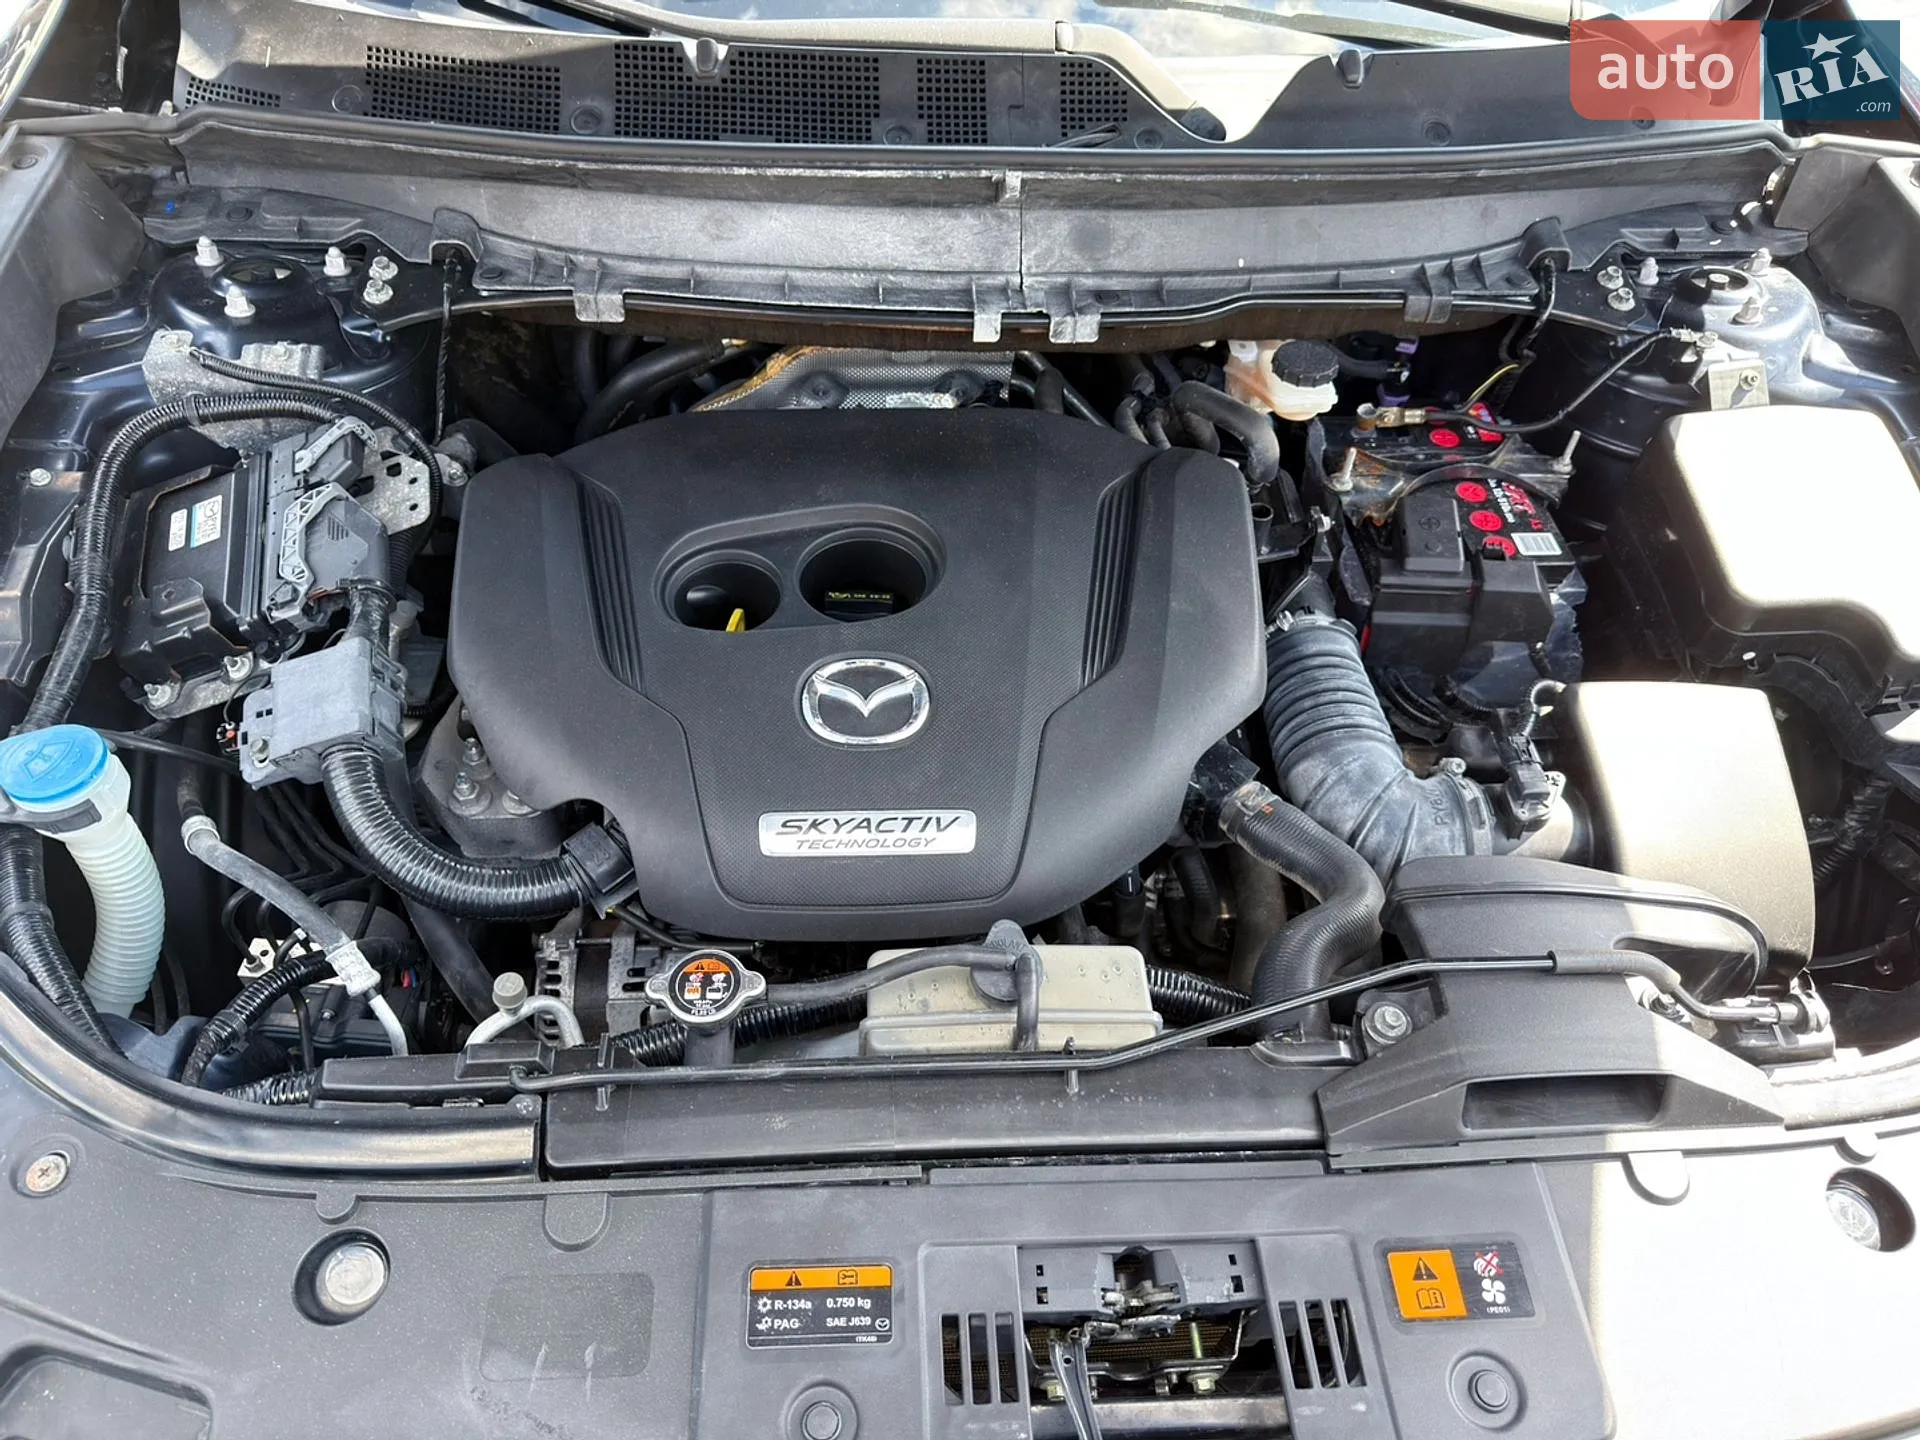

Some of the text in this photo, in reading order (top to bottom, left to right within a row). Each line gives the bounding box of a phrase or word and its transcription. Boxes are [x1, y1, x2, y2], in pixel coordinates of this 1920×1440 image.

[775, 816, 961, 836] SKYACTIV
[796, 837, 936, 850] TECHNOLOGY
[774, 1299, 812, 1310] R-134a
[826, 1297, 871, 1310] 0.750 kg
[774, 1318, 800, 1330] PAG
[826, 1316, 871, 1328] SAE J639
